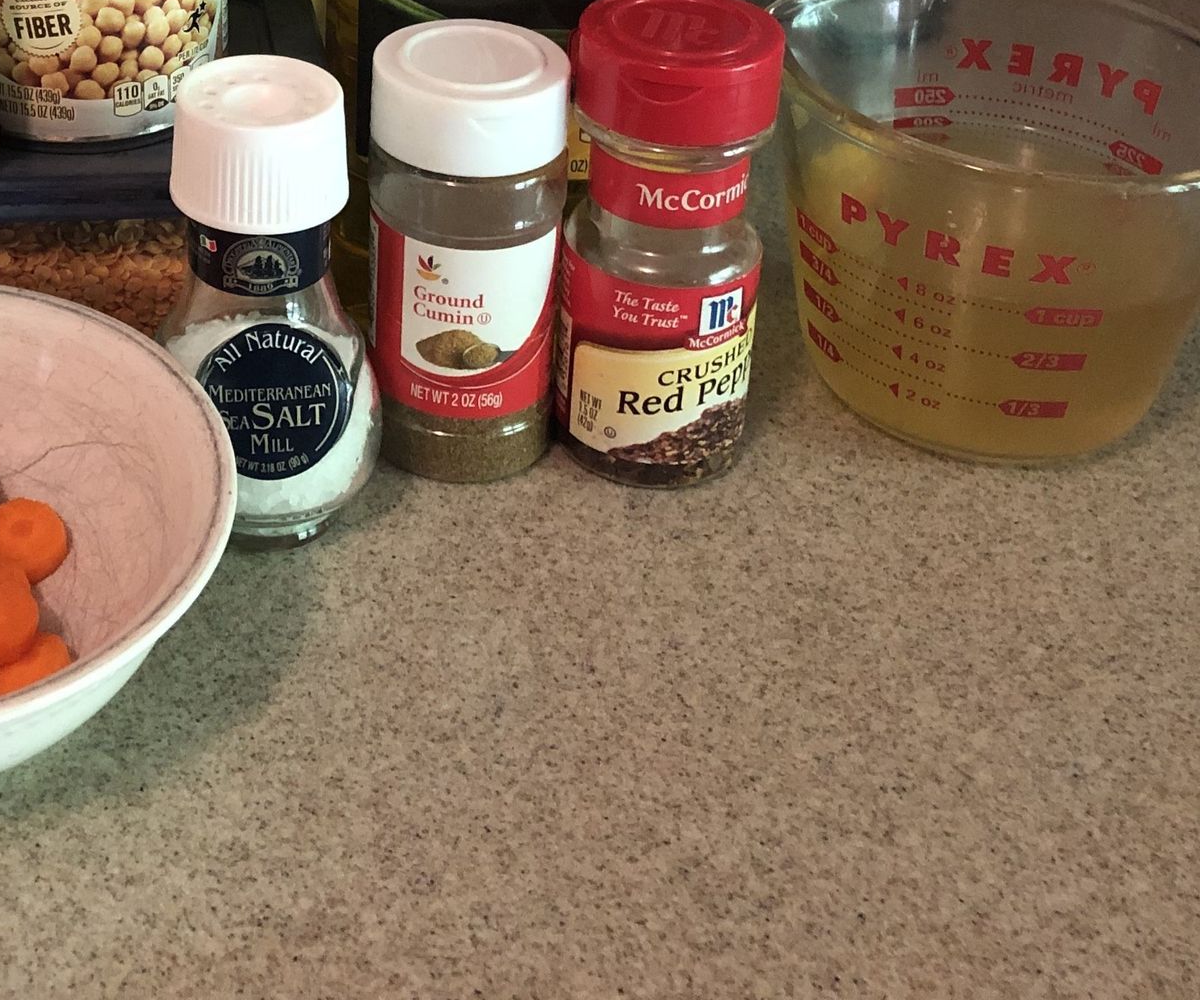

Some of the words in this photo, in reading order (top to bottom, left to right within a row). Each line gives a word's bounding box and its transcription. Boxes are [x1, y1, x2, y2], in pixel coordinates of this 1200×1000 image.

[9, 3, 51, 11] SOURCE
[13, 13, 73, 40] FIBER
[24, 88, 34, 101] OZ
[35, 88, 61, 105] (439g)
[117, 85, 139, 100] 110
[20, 102, 36, 118] 15.5
[37, 105, 48, 118] OZ
[49, 106, 75, 121] (439g)
[570, 159, 588, 174] OZ)
[840, 192, 1078, 285] PYREX
[812, 255, 832, 281] 3/4
[413, 285, 484, 309] Ground
[615, 289, 639, 308] The
[642, 298, 680, 313] Taste
[916, 282, 927, 296] 8
[933, 291, 956, 306] oz
[413, 303, 473, 325] Cumin
[612, 305, 640, 324] You
[643, 315, 680, 329] Trust
[1054, 314, 1095, 327] cup
[688, 320, 746, 349] McCormick
[913, 316, 924, 330] 6
[930, 324, 952, 338] oz
[214, 343, 242, 372] All
[245, 330, 324, 364] Natural
[1022, 354, 1060, 368] 2/3
[910, 352, 919, 364] 4
[925, 360, 946, 373] oz
[208, 383, 331, 403] MEDITERRANEAN
[411, 383, 430, 400] NET
[431, 388, 449, 404] WT
[451, 392, 458, 406] 2
[461, 393, 475, 407] OZ
[477, 391, 503, 409] (56g)
[580, 388, 591, 404] NET
[591, 395, 602, 410] WT
[617, 386, 684, 416] Red
[905, 389, 916, 401] 2
[920, 397, 941, 410] oz
[220, 409, 250, 431] SEA
[252, 403, 326, 430] SALT
[589, 407, 598, 421] OZ
[1007, 401, 1041, 416] 1/3
[250, 433, 294, 454] MILL
[276, 462, 287, 472] OZ
